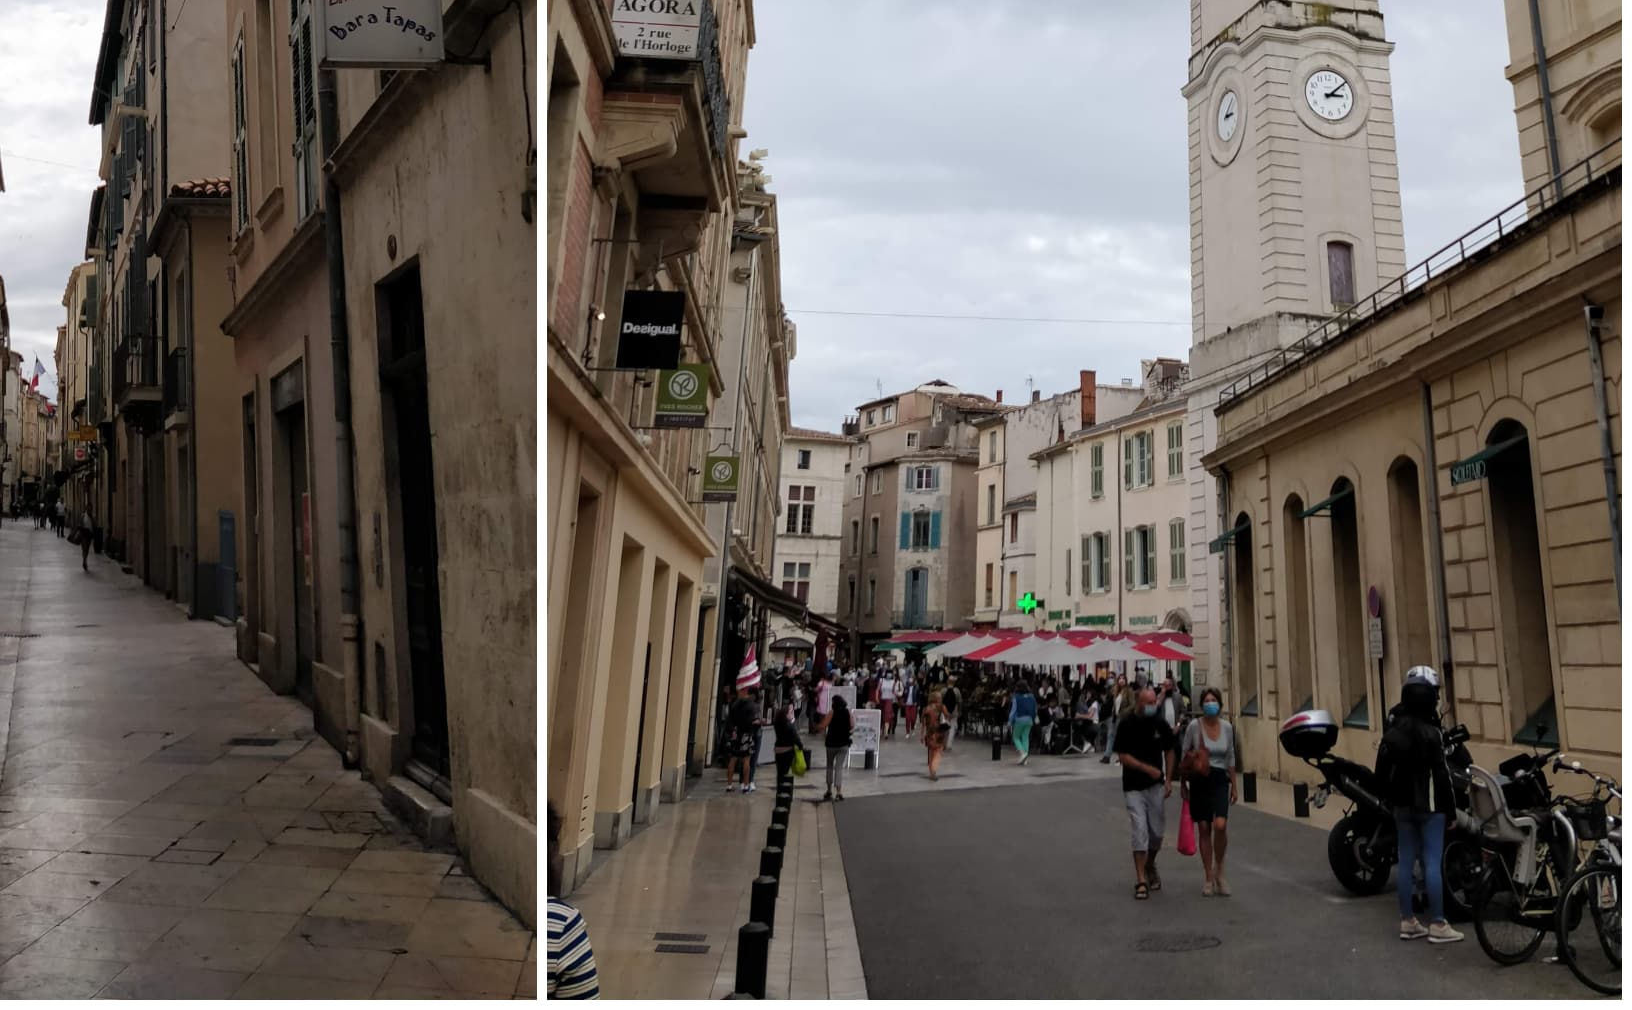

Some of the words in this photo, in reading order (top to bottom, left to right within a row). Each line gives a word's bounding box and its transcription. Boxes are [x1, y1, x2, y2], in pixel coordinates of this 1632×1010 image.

[382, 6, 436, 42] Tapas
[637, 27, 645, 37] 2
[649, 30, 672, 39] rue
[634, 39, 692, 54] l'Horloge
